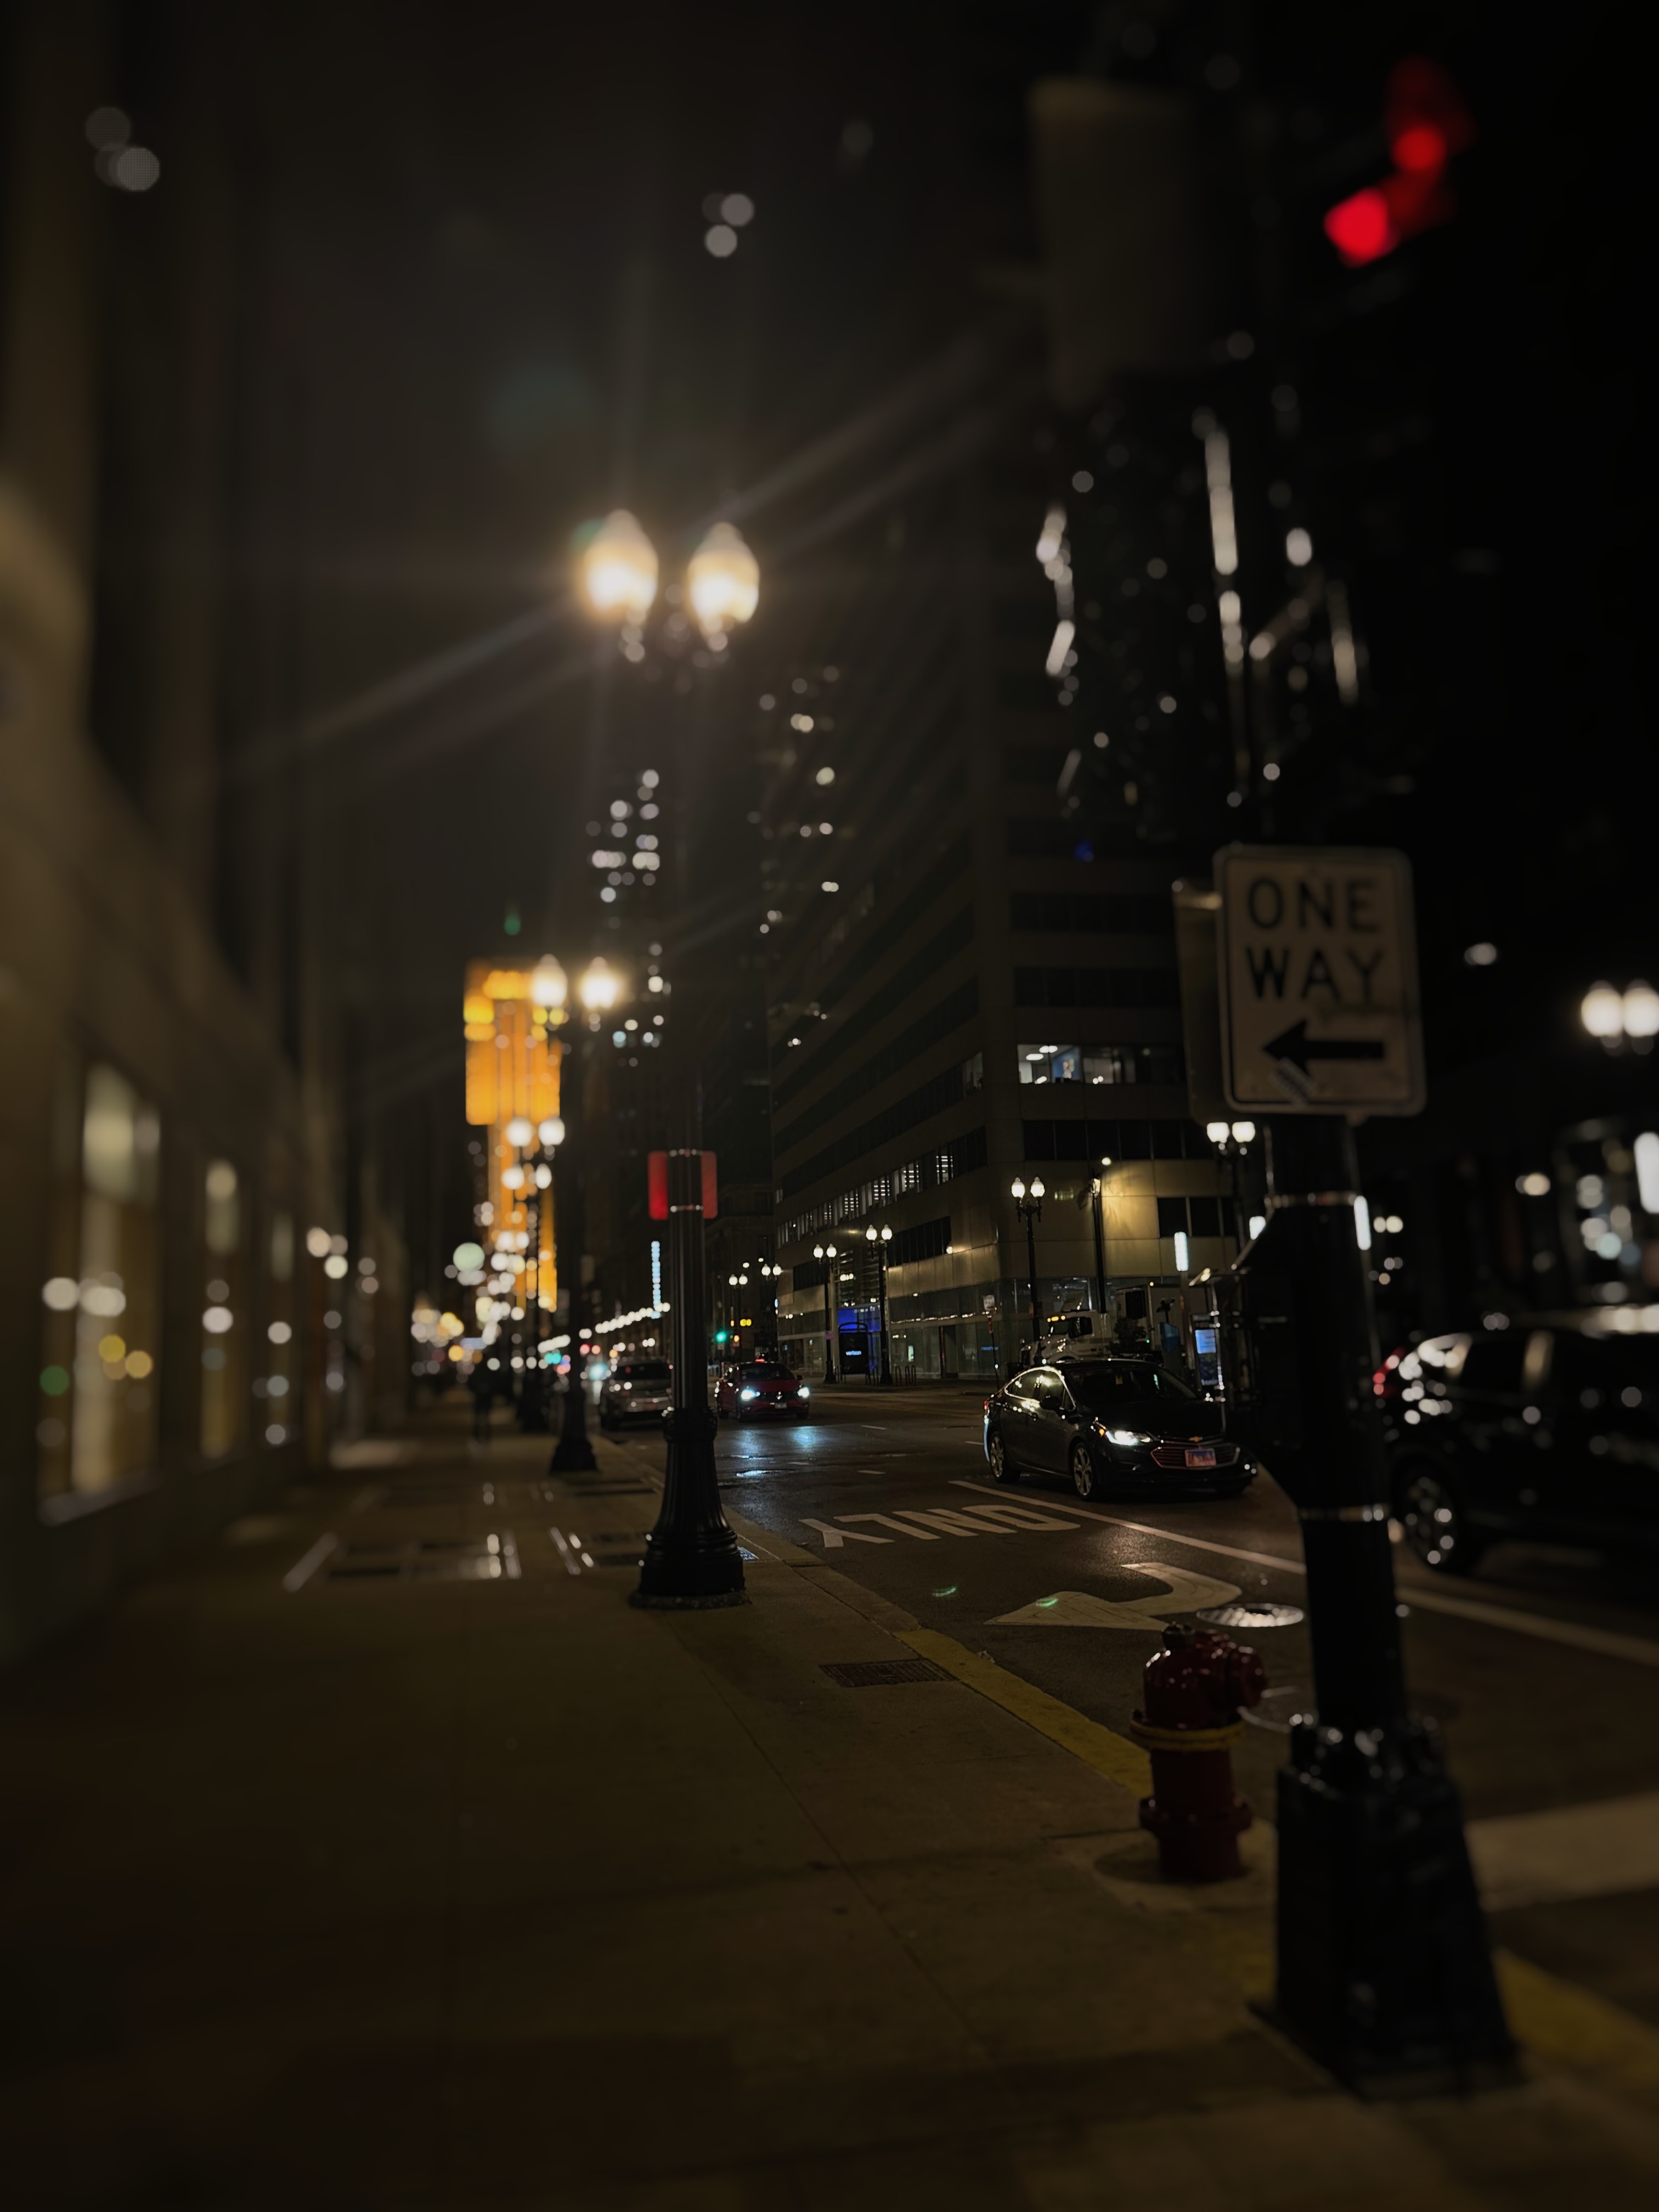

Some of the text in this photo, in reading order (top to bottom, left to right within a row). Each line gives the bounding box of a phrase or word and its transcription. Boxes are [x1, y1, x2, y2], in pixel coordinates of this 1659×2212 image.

[1247, 878, 1378, 932] ONE
[1245, 947, 1383, 1003] WAY
[798, 1505, 1081, 1548] ONLY
